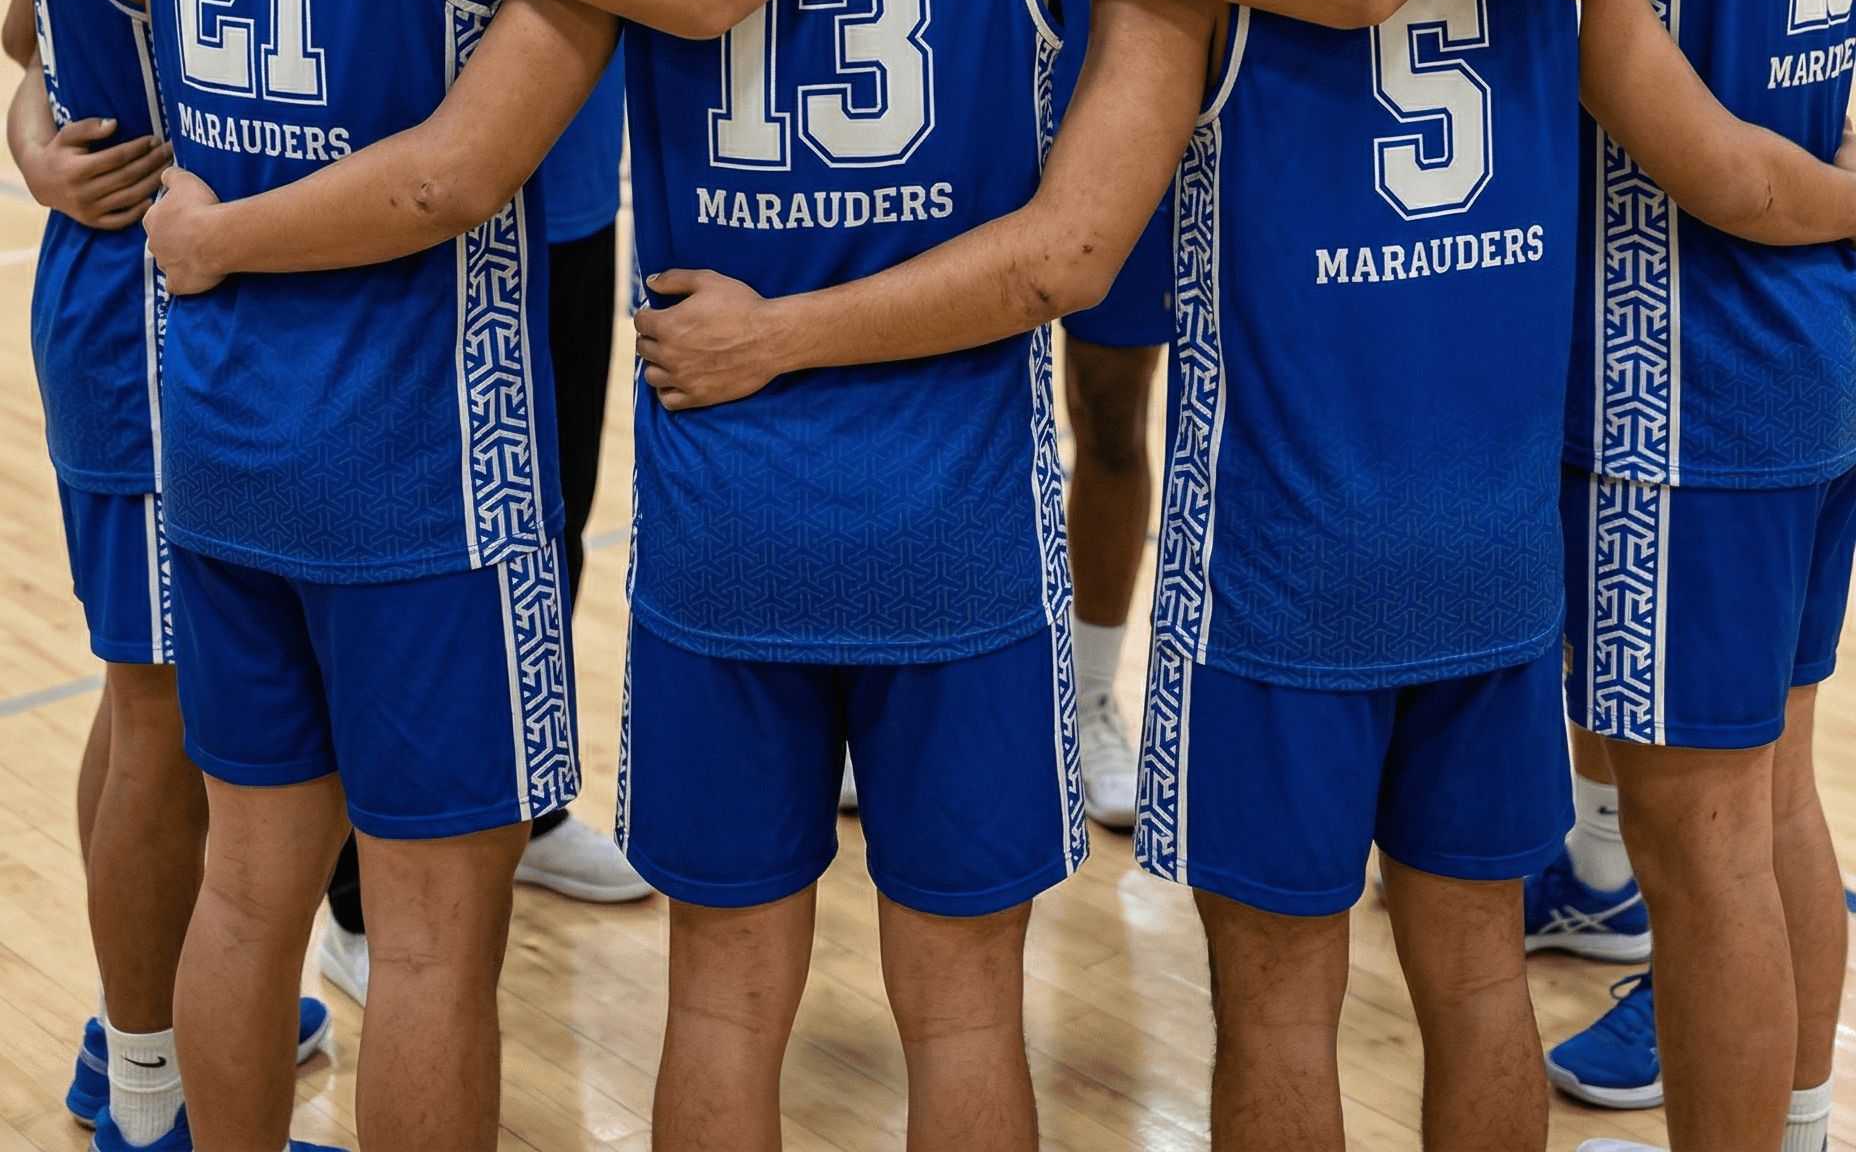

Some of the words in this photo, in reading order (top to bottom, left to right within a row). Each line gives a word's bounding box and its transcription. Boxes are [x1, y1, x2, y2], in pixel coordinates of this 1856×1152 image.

[177, 101, 352, 161] MARAUDERS
[696, 181, 954, 230] MARAUDERS
[1315, 224, 1544, 285] MARAUDERS
